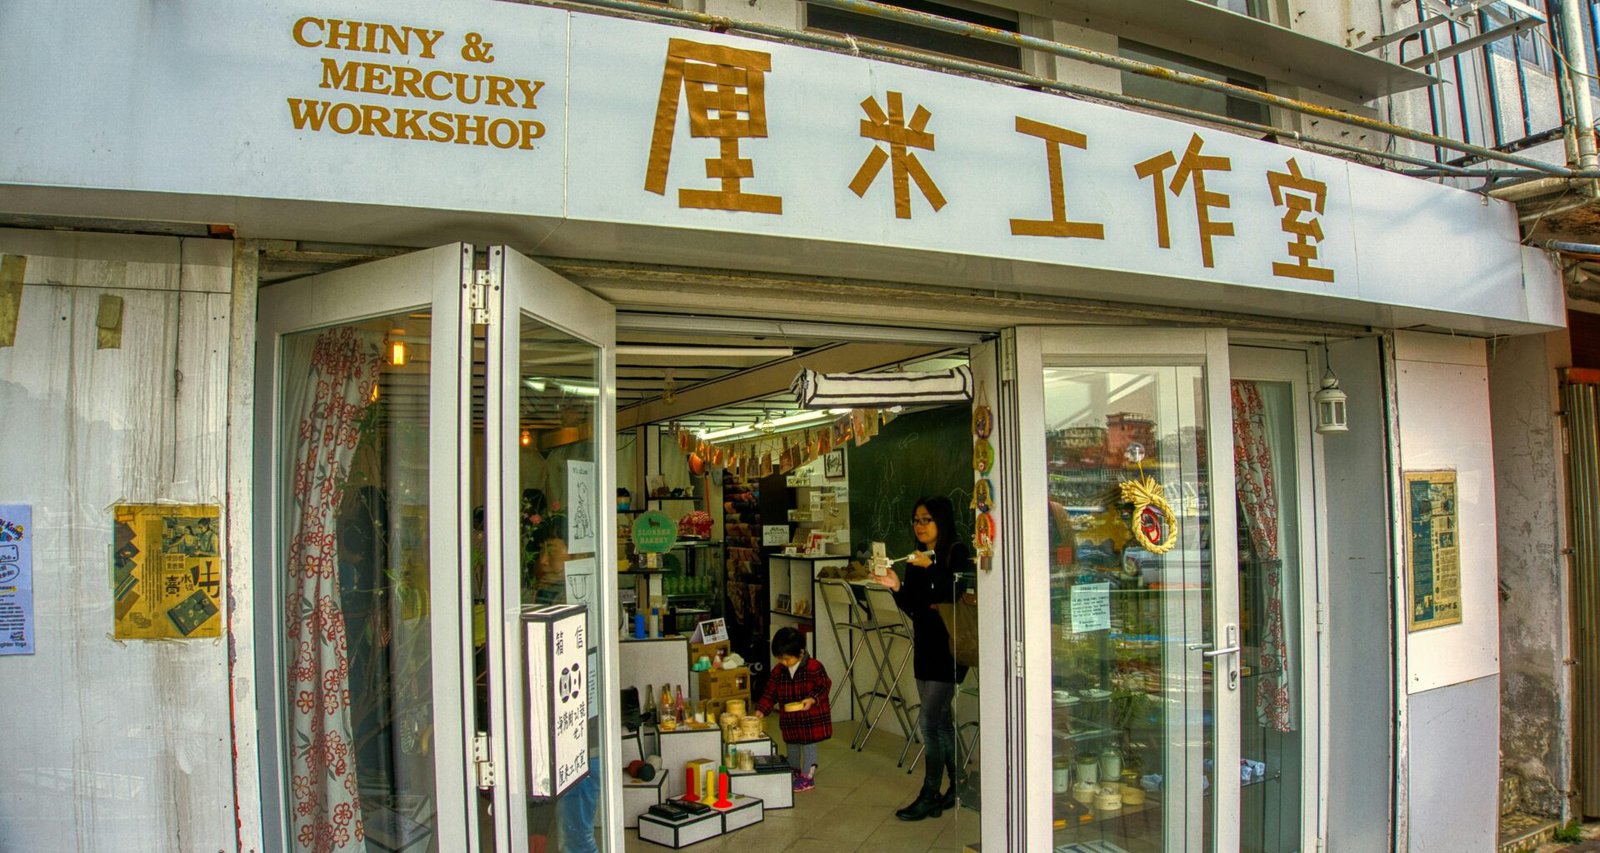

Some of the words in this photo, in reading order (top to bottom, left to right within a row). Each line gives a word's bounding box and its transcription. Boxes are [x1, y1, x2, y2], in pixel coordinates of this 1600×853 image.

[292, 16, 444, 59] CHINY
[460, 32, 495, 64] &
[318, 57, 545, 109] MERCURY
[286, 97, 546, 150] WORKSHOP
[644, 37, 1335, 283] 厘米工作室
